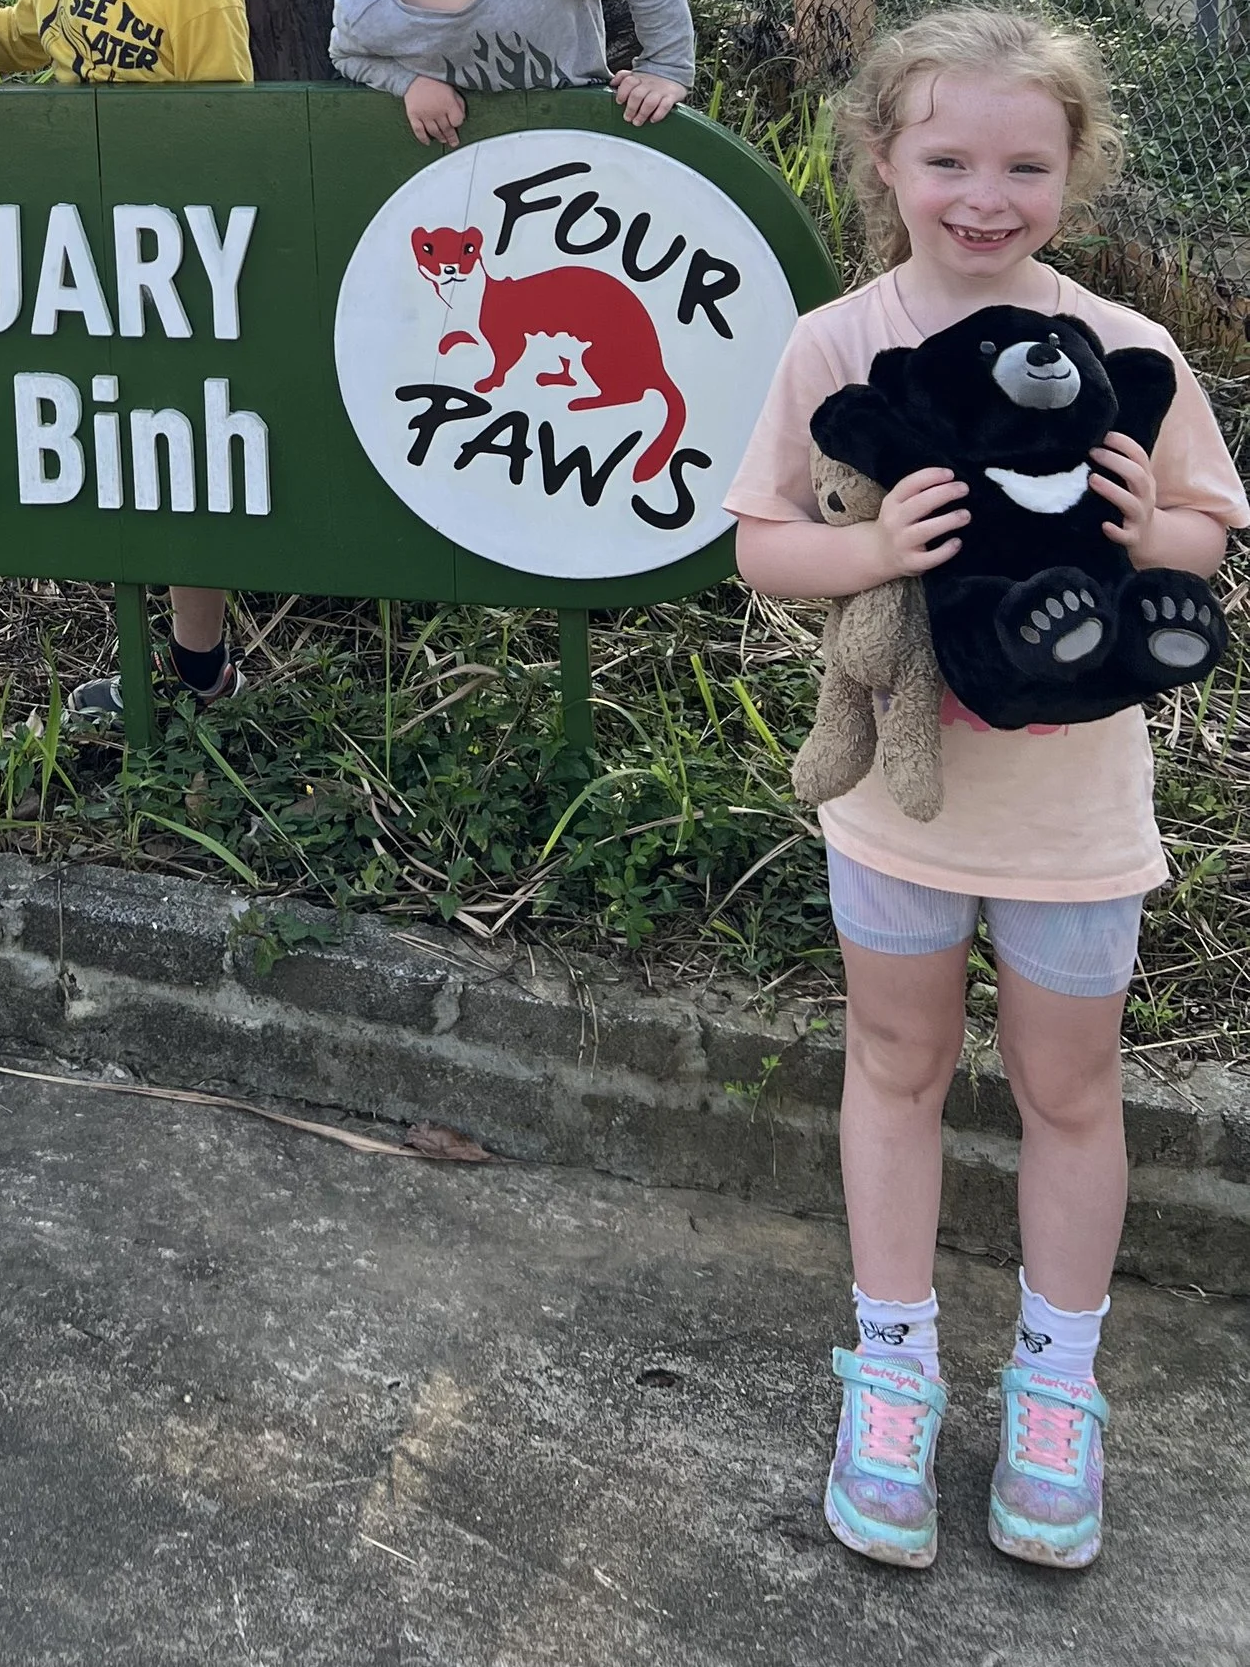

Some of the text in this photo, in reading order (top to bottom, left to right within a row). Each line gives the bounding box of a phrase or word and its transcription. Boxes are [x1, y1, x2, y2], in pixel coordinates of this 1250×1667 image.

[81, 24, 158, 73] LATER
[116, 1, 165, 48] YOU
[493, 161, 742, 340] FOUR
[13, 370, 271, 517] Binh
[394, 383, 713, 531] PAWS
